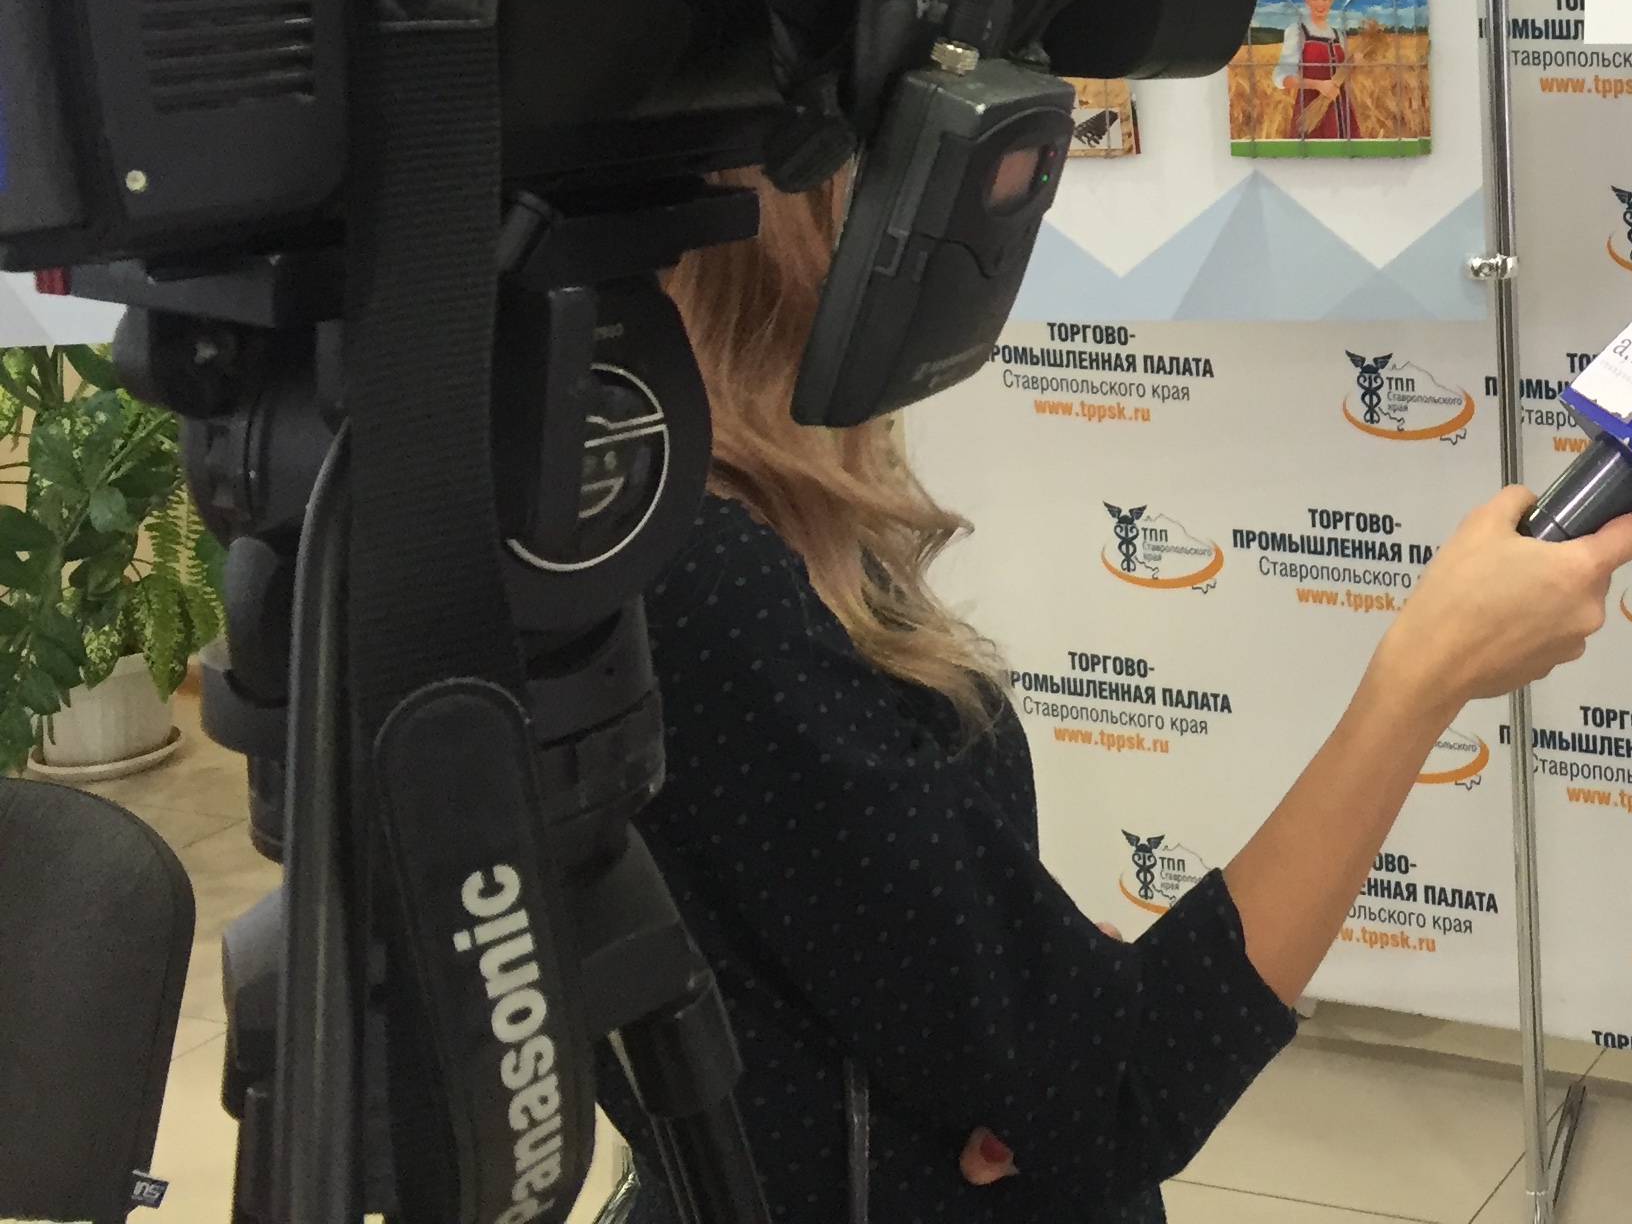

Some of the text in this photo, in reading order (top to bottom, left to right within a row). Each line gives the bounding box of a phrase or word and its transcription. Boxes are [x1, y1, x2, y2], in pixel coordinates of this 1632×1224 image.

[1047, 322, 1136, 346] ТОРГОВО-
[986, 344, 1214, 378] РОМЫШЛЕННАЯ ПАЛАТА
[1002, 369, 1190, 402] Ставропольского края
[1385, 376, 1415, 392] ТПП
[1034, 397, 1151, 423] www.tppsk.ru
[1141, 526, 1168, 543] ТПП
[1308, 508, 1402, 535] ТОРГОВО-
[1232, 528, 1402, 563] ПРОМЫШЛЕННАЯ
[1259, 556, 1412, 588] Ставропольского
[1296, 586, 1404, 612] www.tppsk.
[1068, 651, 1155, 677] ТОРГОВО-
[1162, 687, 1232, 714] ПАЛАТА
[1023, 696, 1208, 736] Ставропольского края
[1054, 725, 1169, 754] www.tppsk.ru
[1159, 856, 1185, 872] ТПП
[1424, 887, 1498, 913] ПАЛАТА
[1432, 911, 1472, 935] края
[453, 863, 563, 1224] Panasonic
